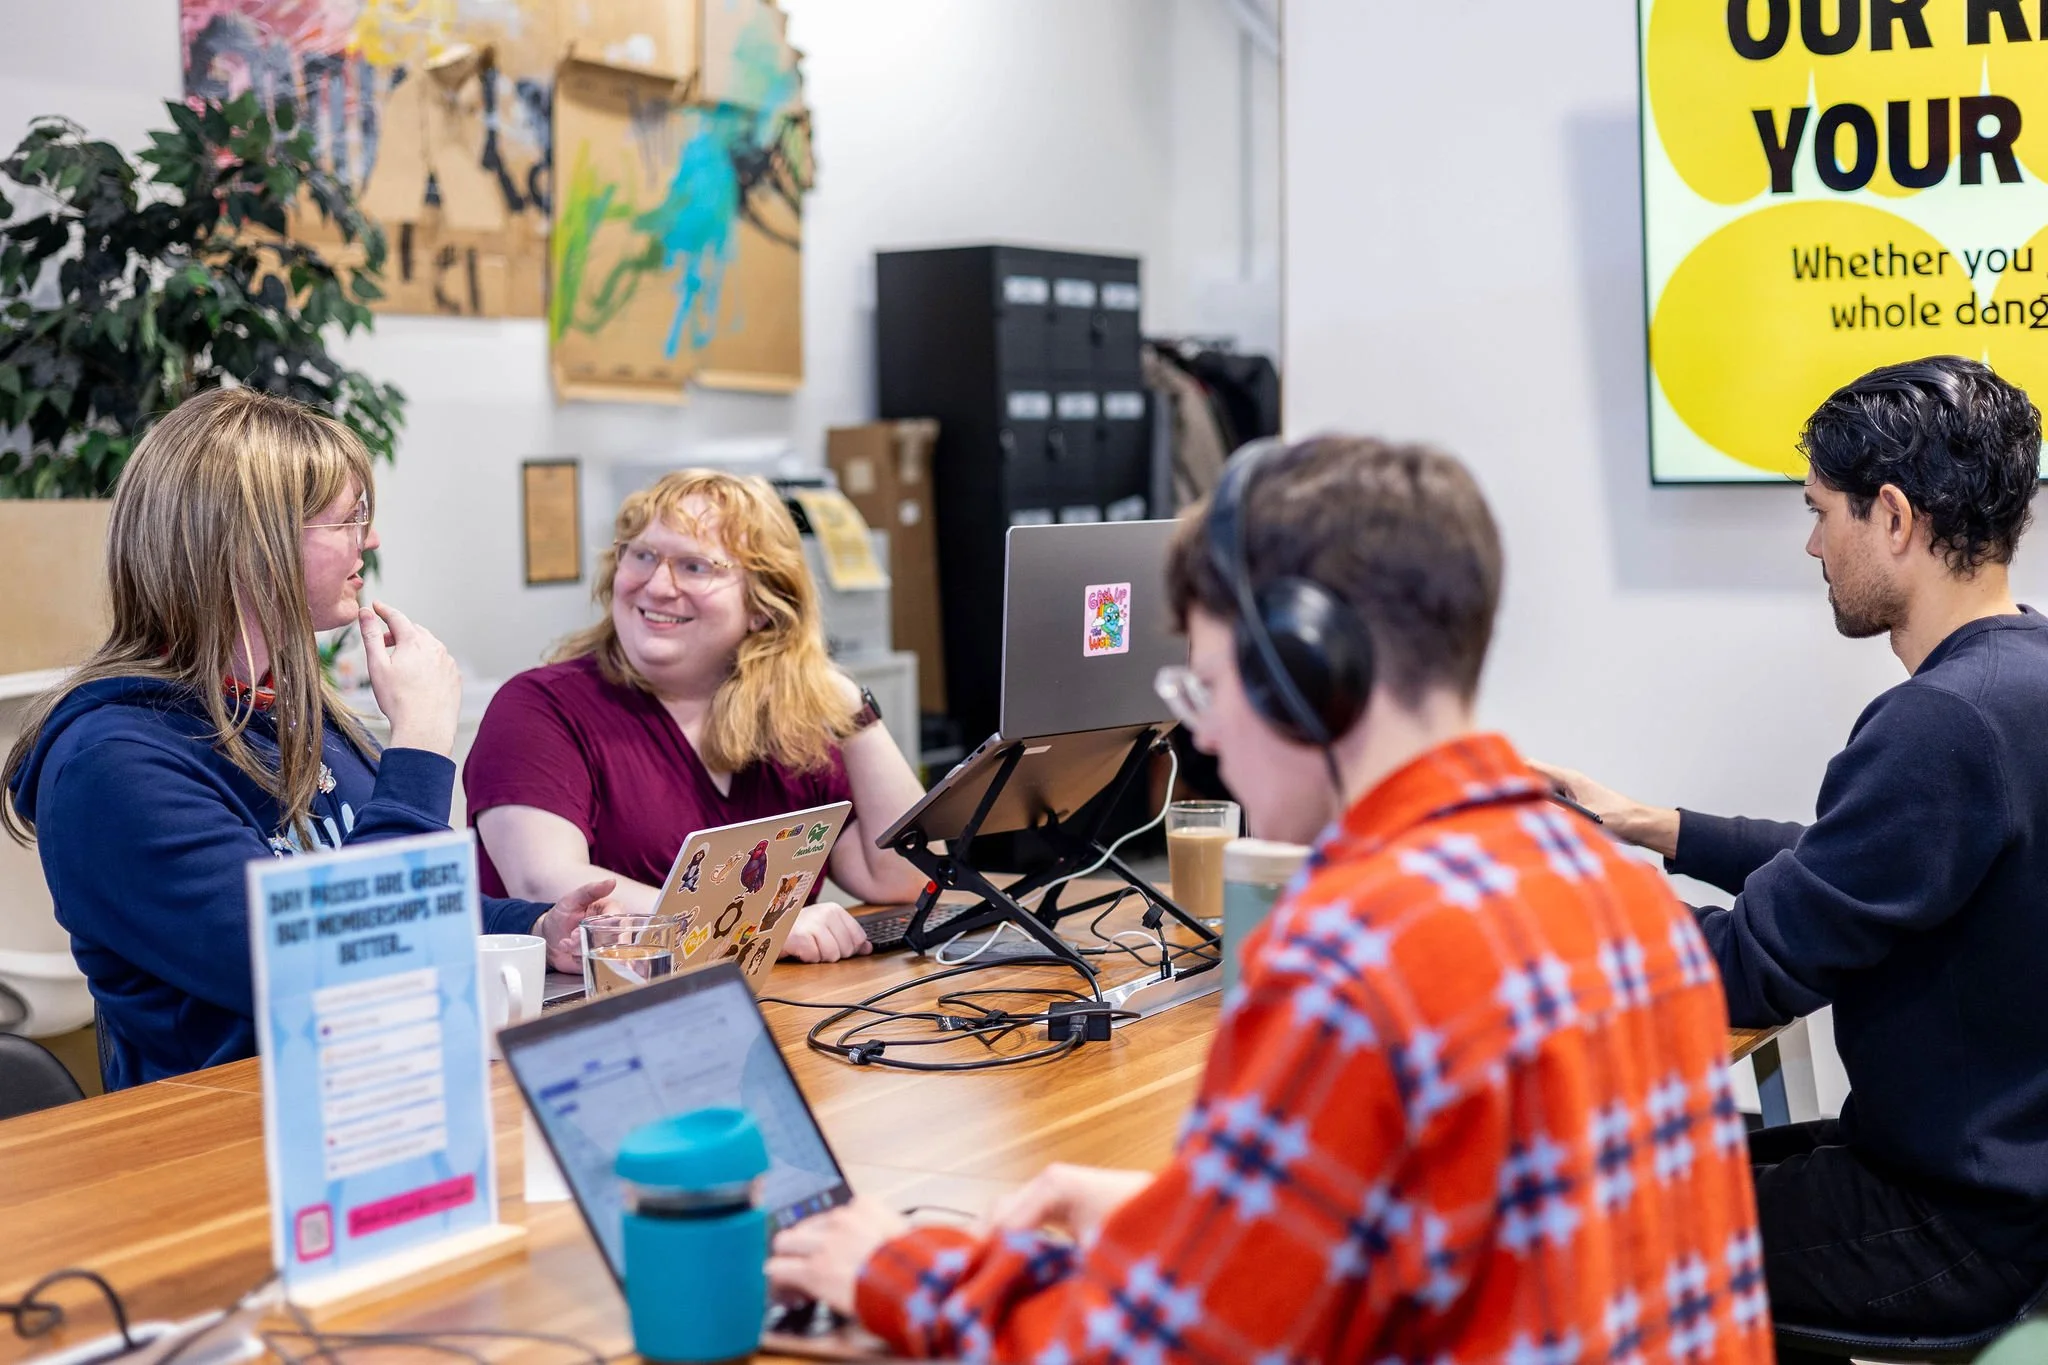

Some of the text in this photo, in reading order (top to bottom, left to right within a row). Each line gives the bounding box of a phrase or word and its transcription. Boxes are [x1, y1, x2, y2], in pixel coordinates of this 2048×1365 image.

[1727, 0, 2048, 60] OUR R
[1752, 95, 2024, 194] YOUR
[1792, 242, 2034, 281] Whether you
[1831, 291, 2048, 330] whole dang
[269, 889, 303, 916] DAY
[310, 877, 369, 907] PASSES
[374, 871, 404, 895] ARE
[276, 890, 465, 946] BUT MEMBERSHIPS ARE
